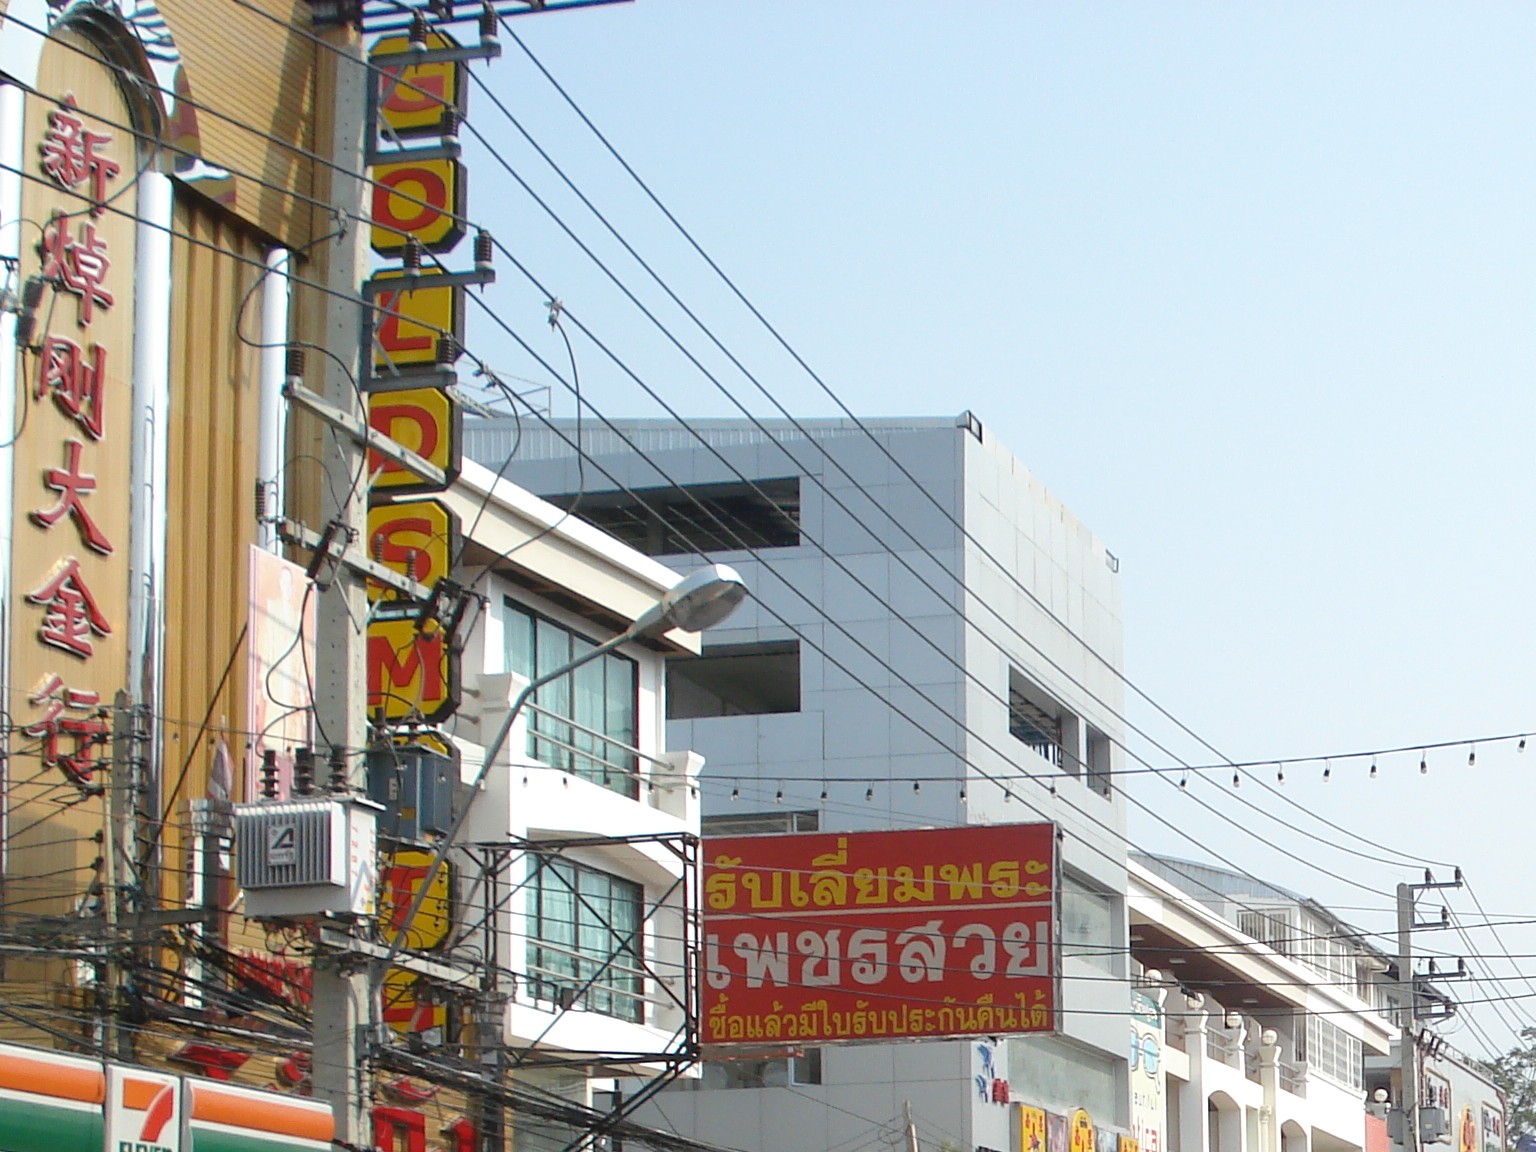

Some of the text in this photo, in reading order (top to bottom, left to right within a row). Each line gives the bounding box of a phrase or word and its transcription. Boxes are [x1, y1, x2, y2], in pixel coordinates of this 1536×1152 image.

[704, 837, 1050, 910] รับเลี่ยมพระ
[705, 919, 1050, 990] เพชรสวย
